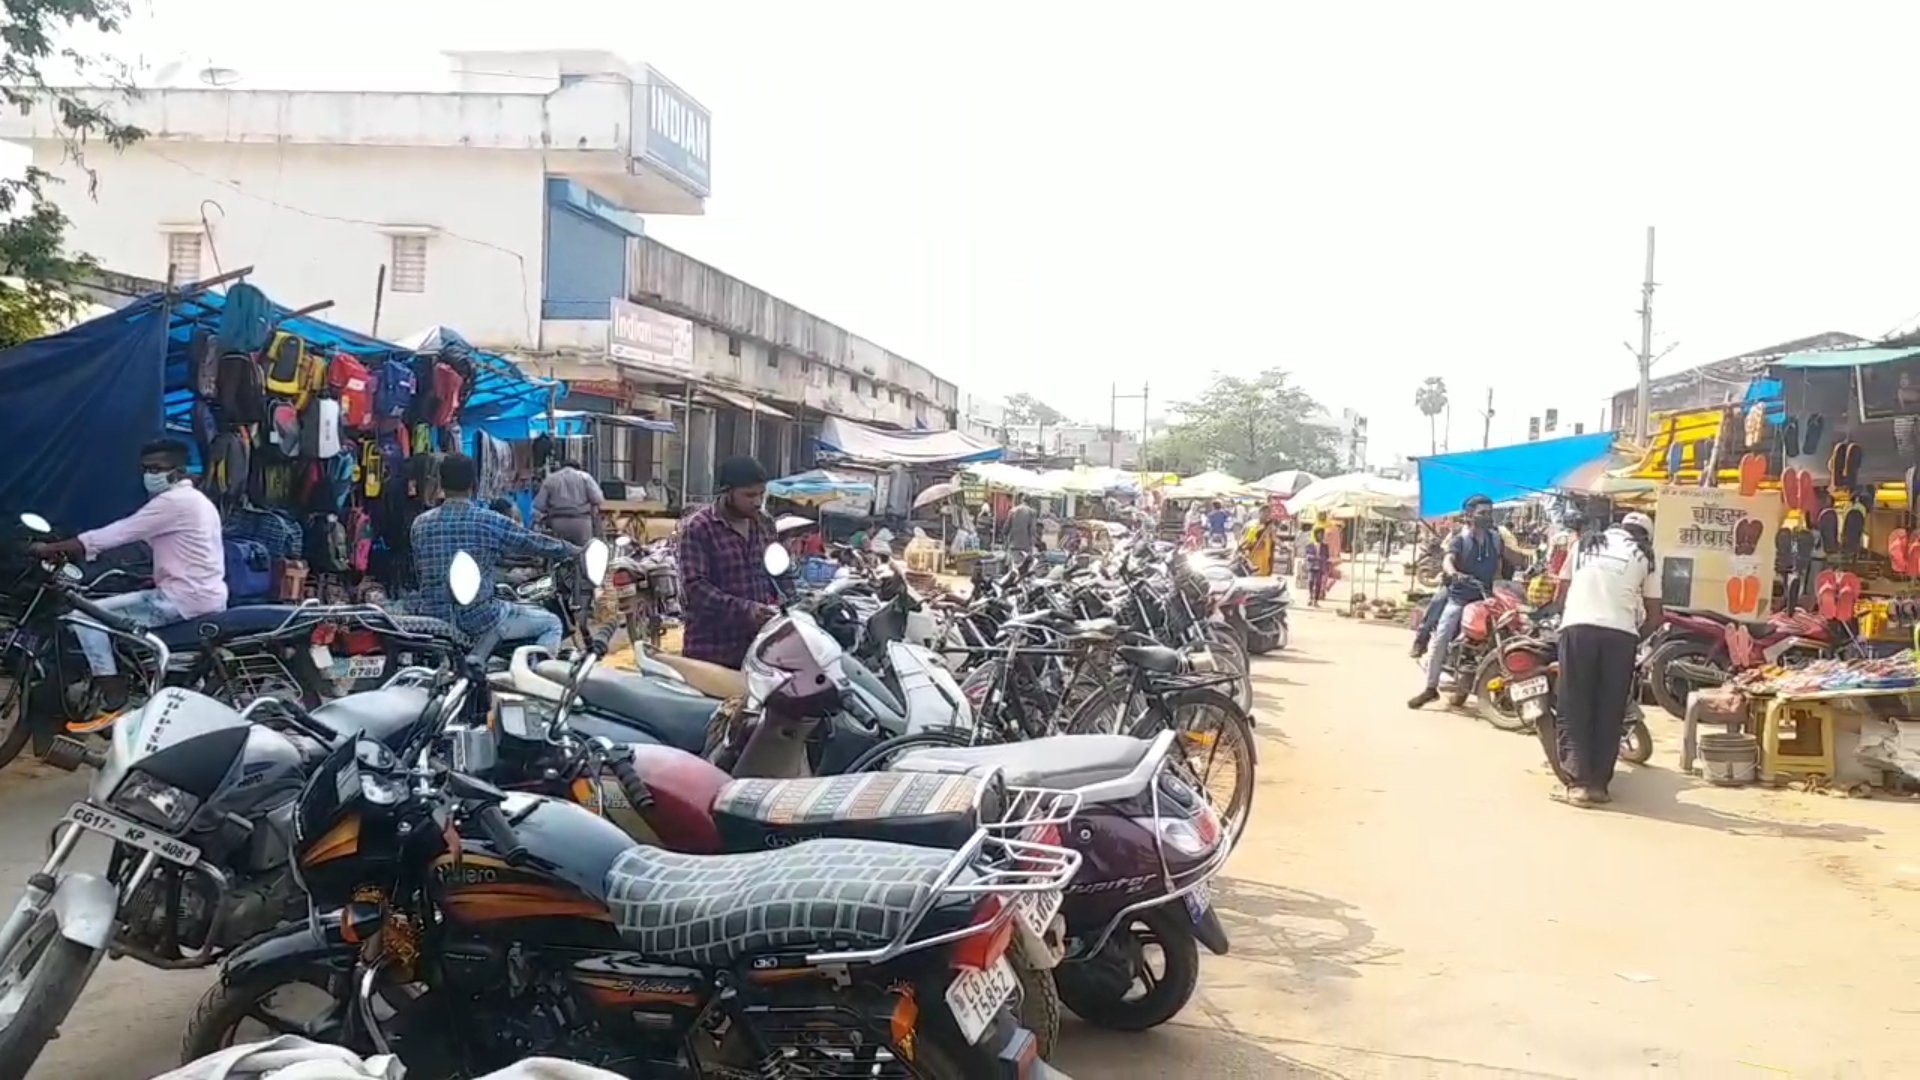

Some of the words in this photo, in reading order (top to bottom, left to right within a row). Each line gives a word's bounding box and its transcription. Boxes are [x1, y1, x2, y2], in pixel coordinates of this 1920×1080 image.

[650, 83, 707, 162] INDIAN
[614, 305, 652, 343] Indian
[125, 827, 146, 841] KP
[972, 970, 1010, 1025] T5852
